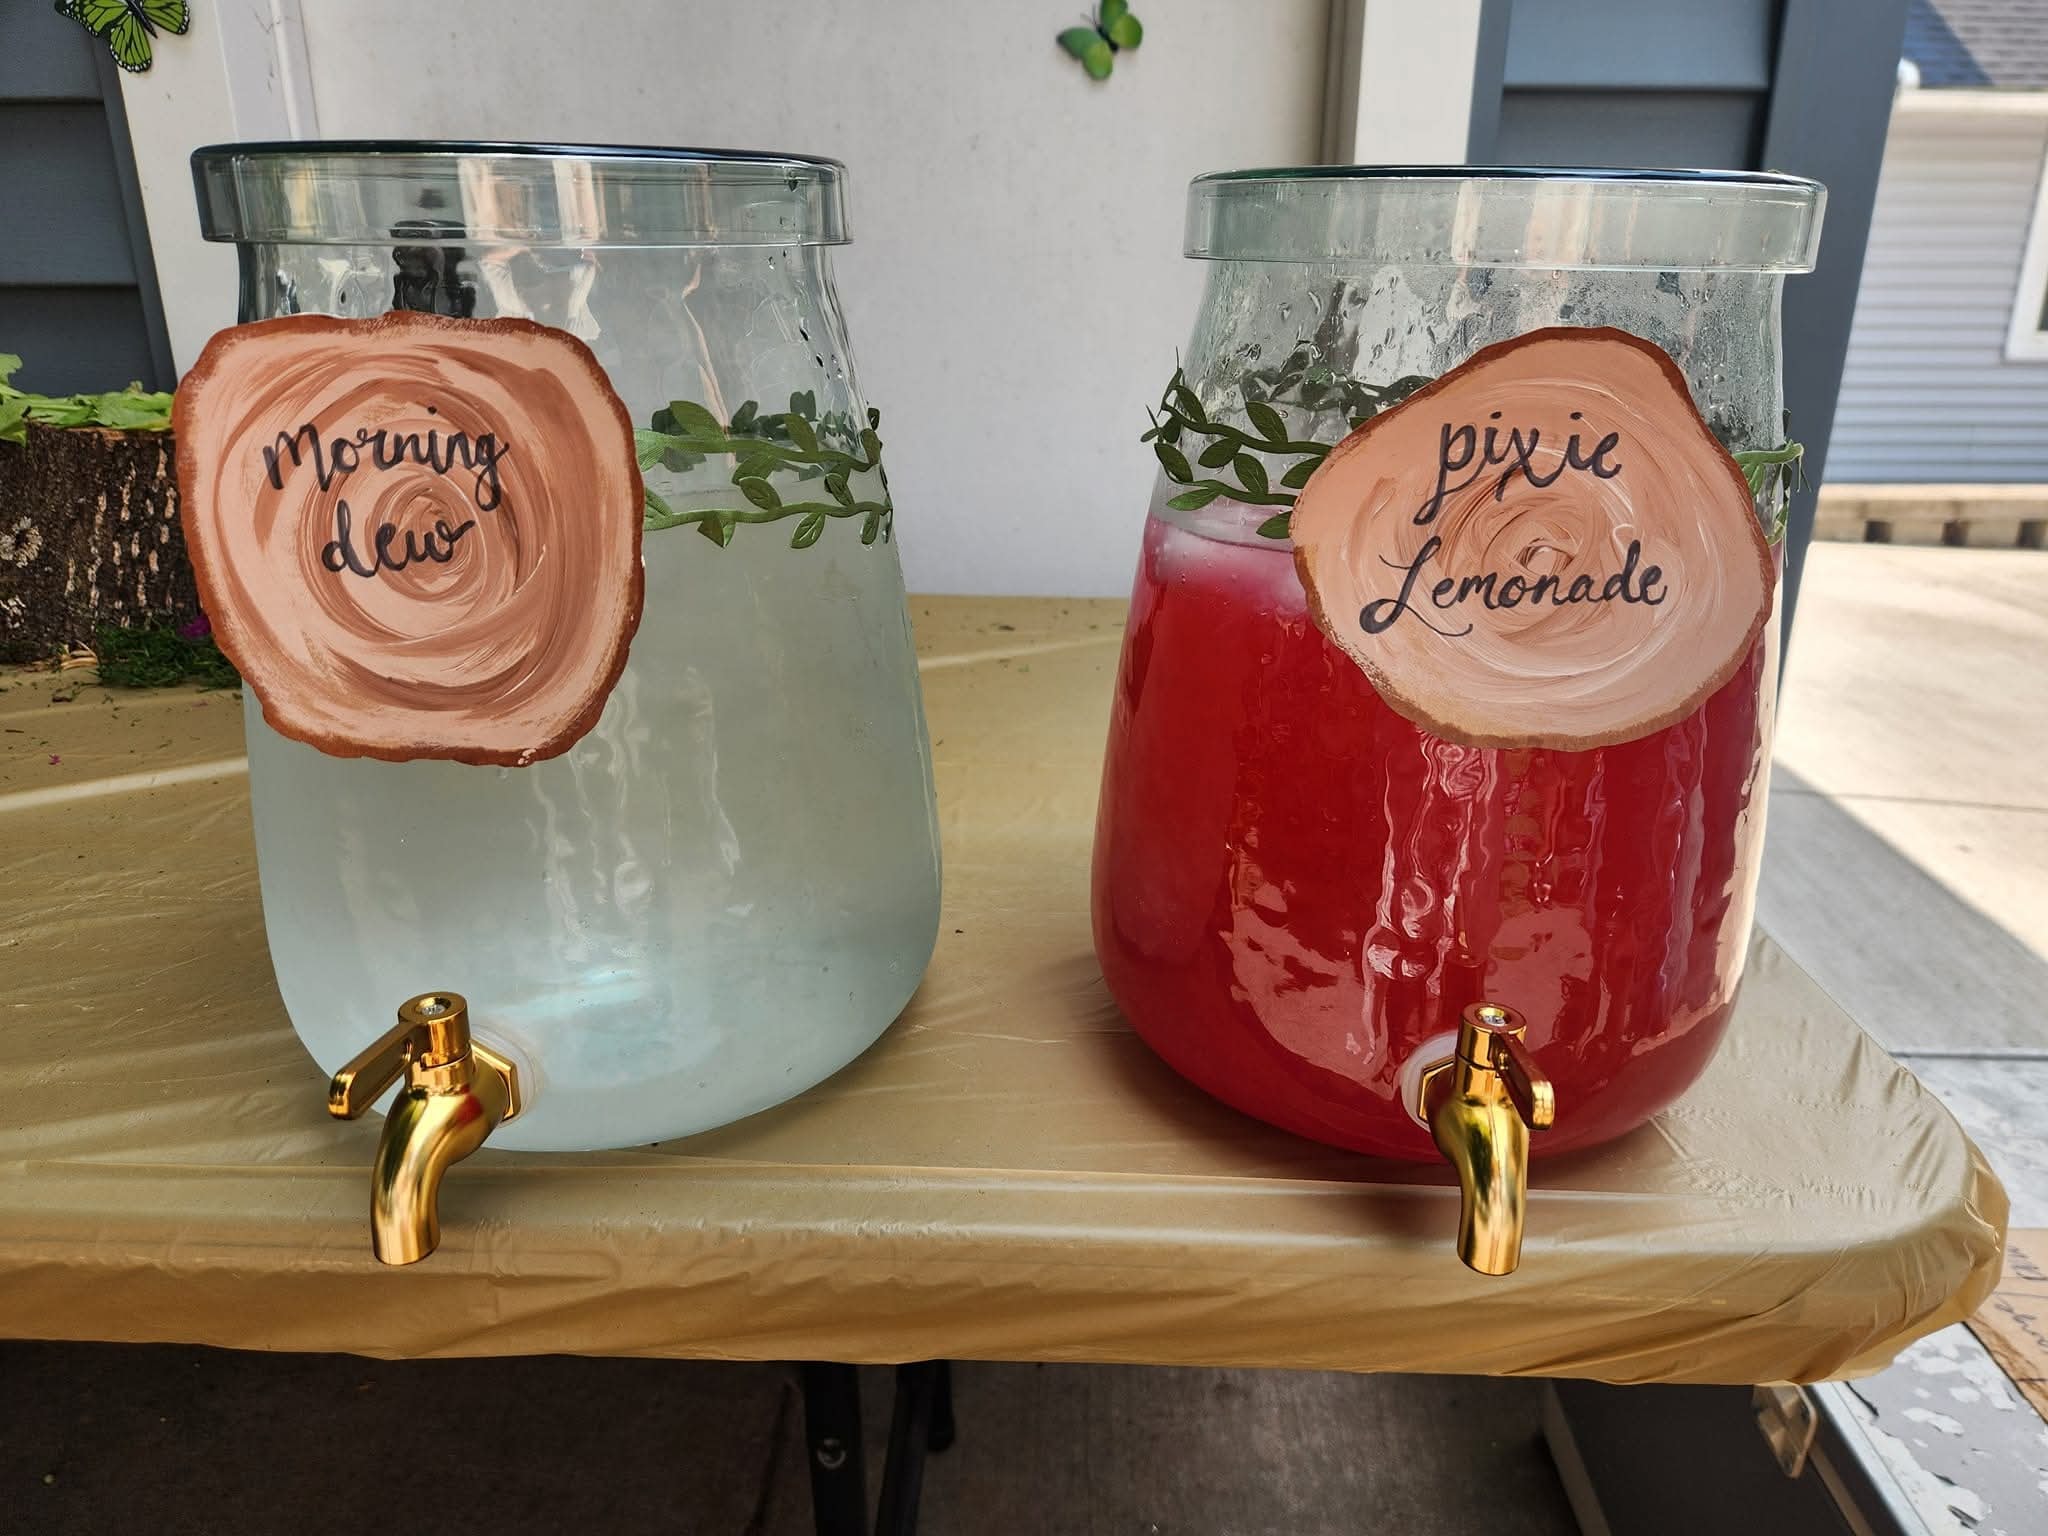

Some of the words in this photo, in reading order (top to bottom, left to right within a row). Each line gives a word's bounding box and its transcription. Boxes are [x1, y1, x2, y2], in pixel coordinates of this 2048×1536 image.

[262, 406, 511, 512] Morning
[1413, 411, 1623, 526] pixie
[321, 500, 476, 578] dew
[1359, 536, 1668, 638] Lemonade
